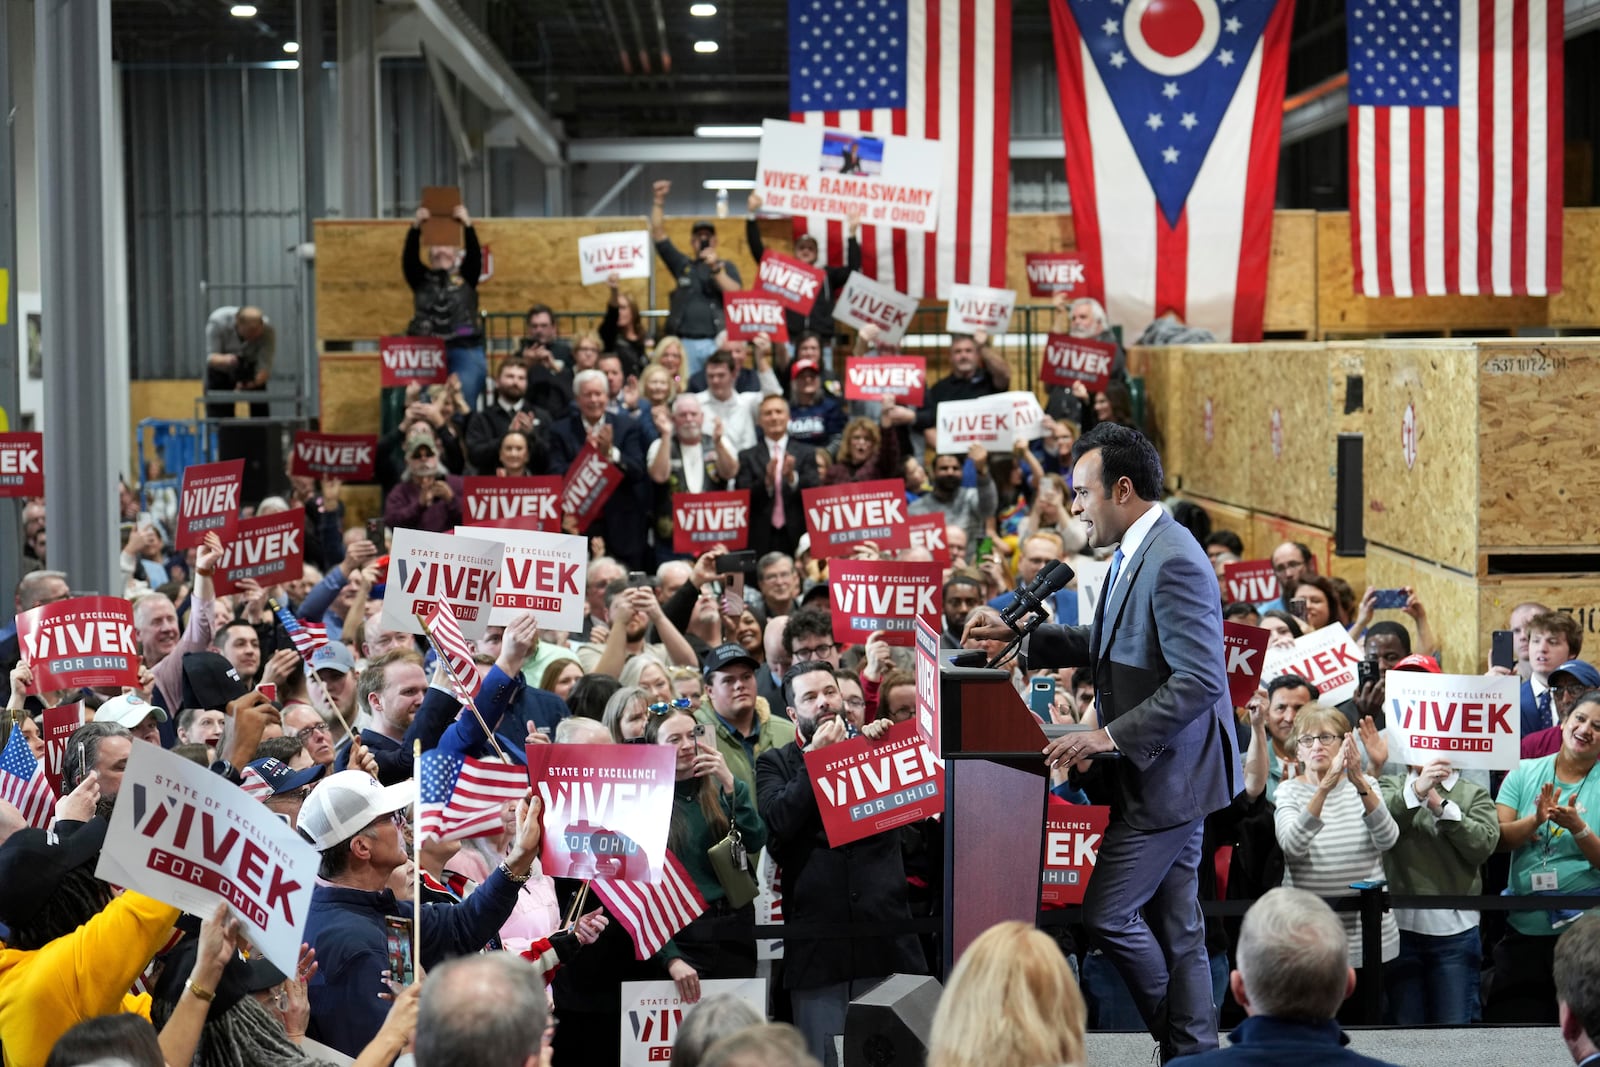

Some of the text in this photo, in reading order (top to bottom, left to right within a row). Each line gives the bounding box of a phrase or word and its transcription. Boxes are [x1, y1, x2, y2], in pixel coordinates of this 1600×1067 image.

[763, 170, 934, 206] VIVEK RAMASWAMY
[766, 192, 926, 224] for GOVERNOR of OHIO
[583, 244, 645, 265] VIVEK
[760, 261, 818, 299] VIVEK
[1027, 264, 1085, 283] VIVEK
[727, 304, 784, 325] VIVEK
[848, 287, 908, 327] VIVEK
[954, 298, 1009, 319] VIVEK
[383, 349, 444, 368] VIVEK
[1047, 345, 1111, 376] VIVEK
[848, 367, 922, 389] VIVEK
[942, 413, 1009, 433] VIVEK
[297, 443, 371, 465] VIVEK
[561, 453, 608, 514] VIVEK
[183, 482, 239, 518] VIVEK
[467, 495, 558, 520] VIVEK
[676, 506, 748, 531] VIVEK
[808, 498, 905, 533] VIVEK
[830, 527, 892, 542] FOR OHIO
[215, 528, 300, 569] VIVEK
[411, 548, 440, 559] STATE
[457, 554, 494, 566] EXCELLENCE
[521, 547, 572, 559] EXCELLENCE
[228, 560, 286, 580] FOR OHIO
[397, 558, 497, 603] VIVEK
[496, 557, 580, 595] VEK
[841, 574, 930, 583] STATE OF EXCELLENCE
[833, 582, 937, 615] VIVEK
[1229, 575, 1277, 602] VIV
[415, 602, 478, 619] FO OHIO
[495, 594, 560, 610] OR OHIO
[38, 611, 128, 627] TATE OF EXCELLENCE
[852, 618, 878, 630] FOR
[23, 621, 137, 659] VIVEK
[52, 657, 128, 672] FOR OHIO
[1281, 643, 1360, 683] VEK
[1321, 671, 1354, 691] OHIO
[1402, 688, 1503, 700] STATE OF EXCELLENCE
[1392, 698, 1513, 734] VIVEK
[52, 724, 68, 735] STATE
[825, 735, 925, 771] STATE OF EXCELLEN
[1411, 736, 1491, 750] FOR OHIO
[548, 767, 657, 780] STATE OF EXCELLENCE
[817, 744, 945, 808] VIVEK
[852, 783, 936, 818] FOR OHIO
[154, 775, 295, 869] STATE OF EXCELLENCE
[1045, 821, 1091, 830] ELLENCE
[560, 835, 638, 853] FOR OHIO
[133, 783, 302, 928] VIVEK
[1042, 871, 1077, 883] HIO
[153, 852, 204, 883] FOR
[218, 879, 267, 926] OHIO
[640, 998, 668, 1006] STATE
[651, 1049, 671, 1059] FO
